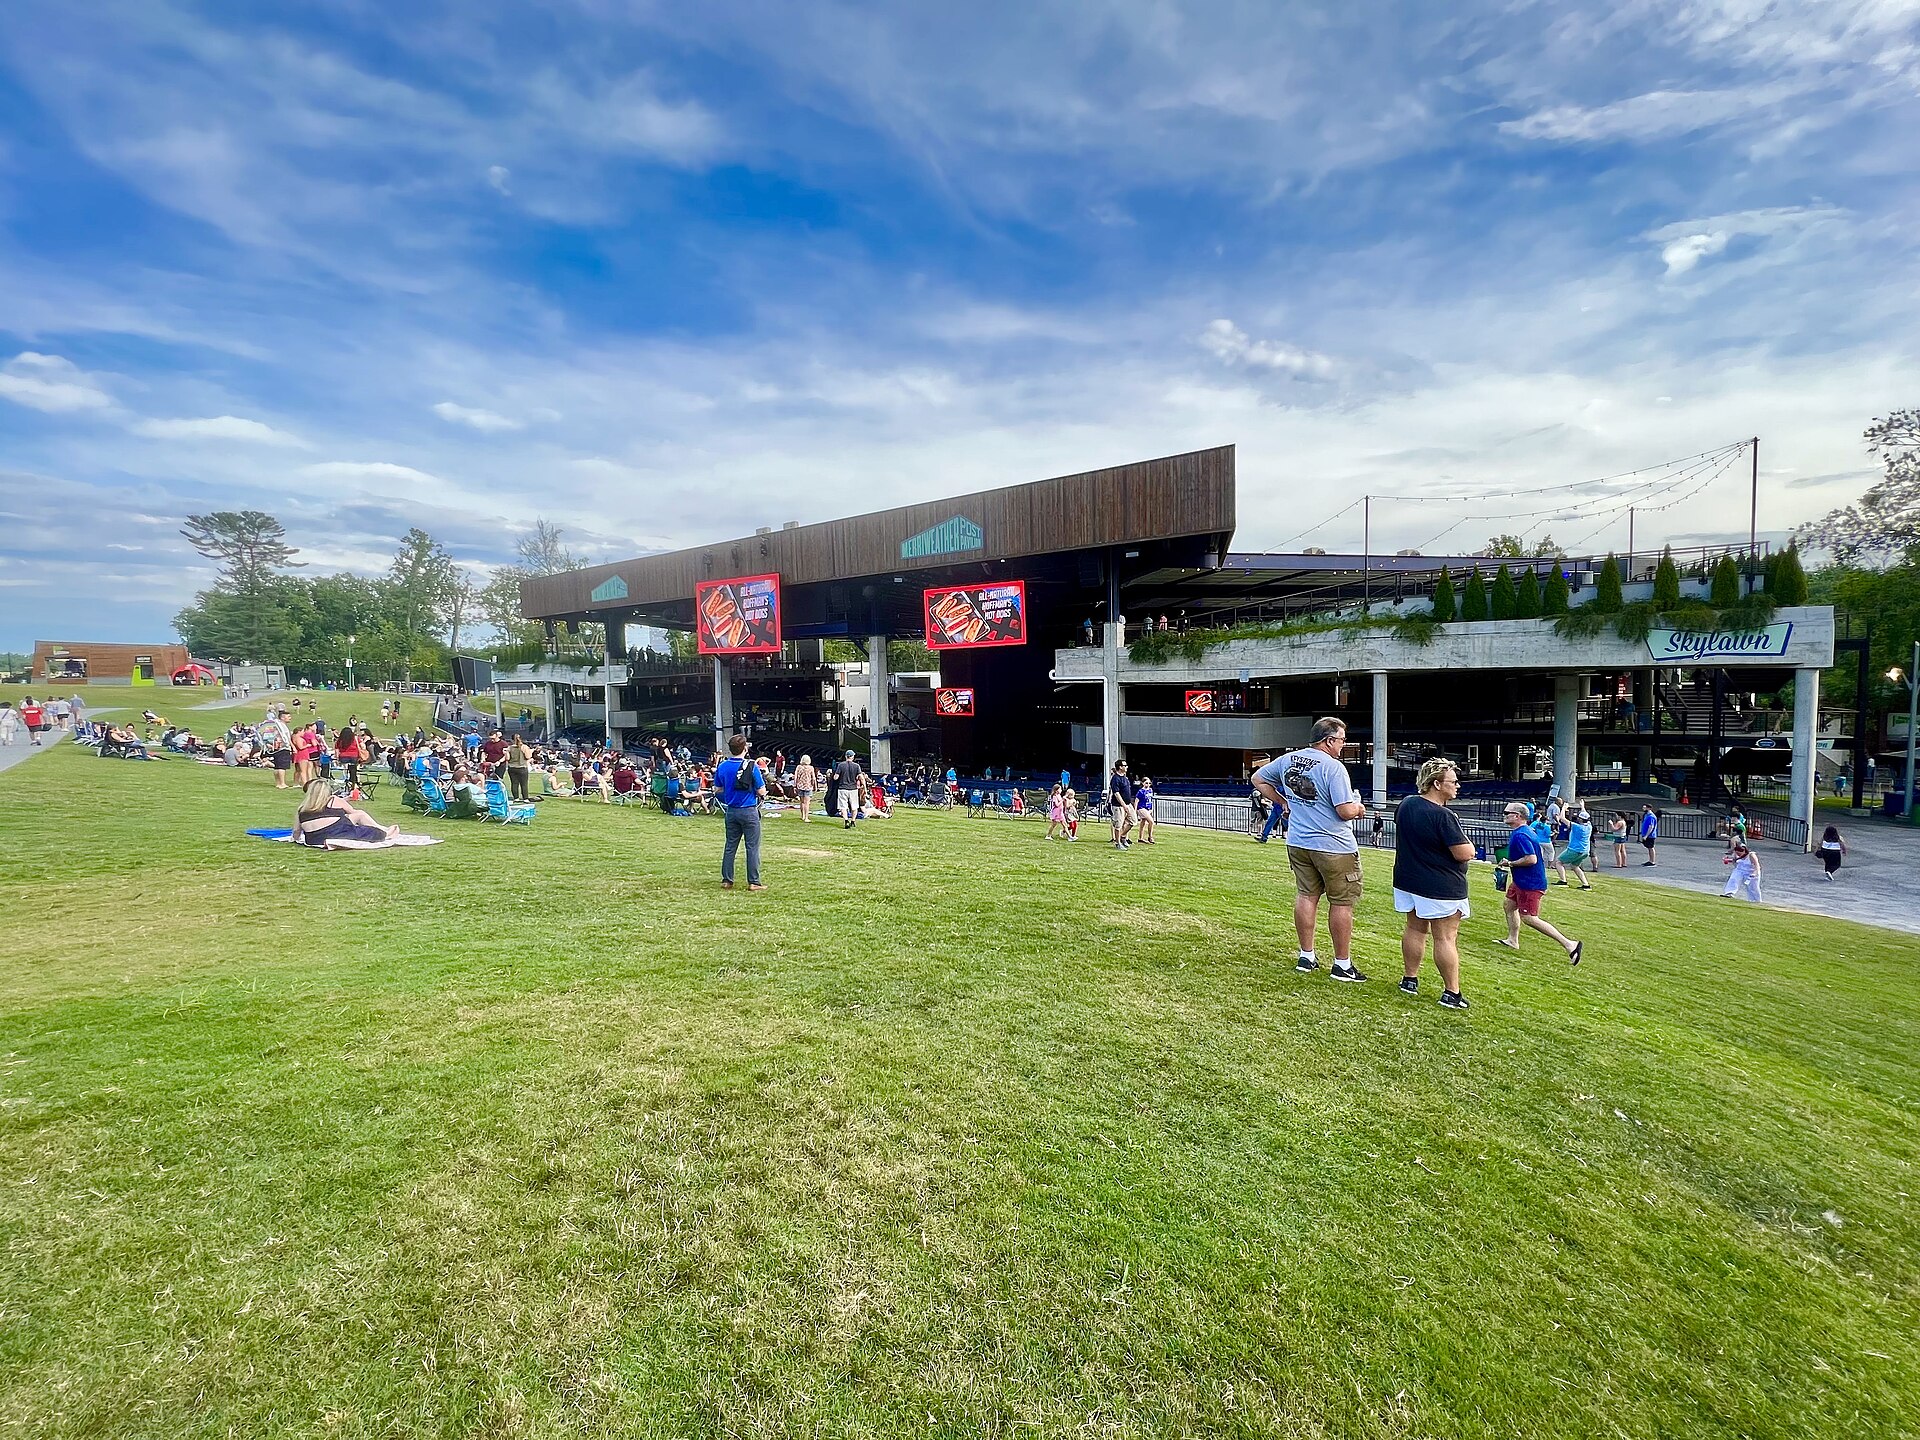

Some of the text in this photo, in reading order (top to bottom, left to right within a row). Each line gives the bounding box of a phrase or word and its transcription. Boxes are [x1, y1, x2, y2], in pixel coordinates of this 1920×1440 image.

[960, 518, 981, 539] POST
[901, 516, 960, 558] MERRIWEATHER
[979, 587, 1015, 601] ALL-NATURAL
[743, 595, 769, 609] HOFFMAN'S
[982, 599, 1012, 611] HOFFMAN'S
[745, 608, 768, 621] HOT DOGS
[984, 609, 1011, 620] HOT DOGS
[1664, 630, 1772, 660] Skylawn
